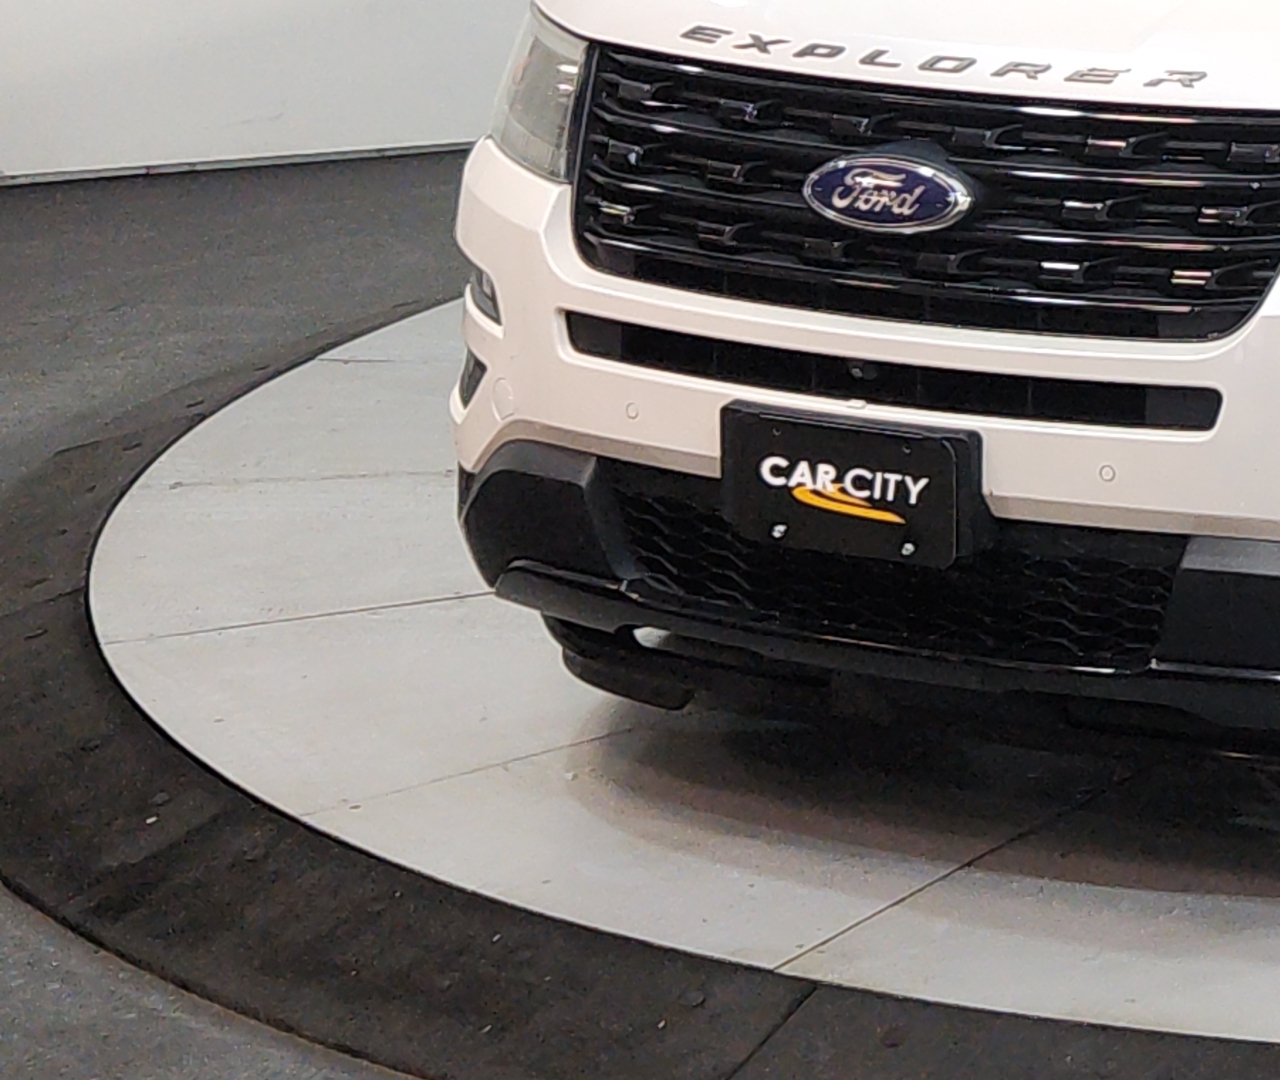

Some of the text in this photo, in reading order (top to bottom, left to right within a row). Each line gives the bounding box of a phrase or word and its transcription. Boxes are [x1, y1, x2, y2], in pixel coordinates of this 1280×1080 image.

[680, 25, 1208, 89] EXPLORER
[831, 168, 926, 216] Ford
[760, 456, 930, 505] CAR CITY
